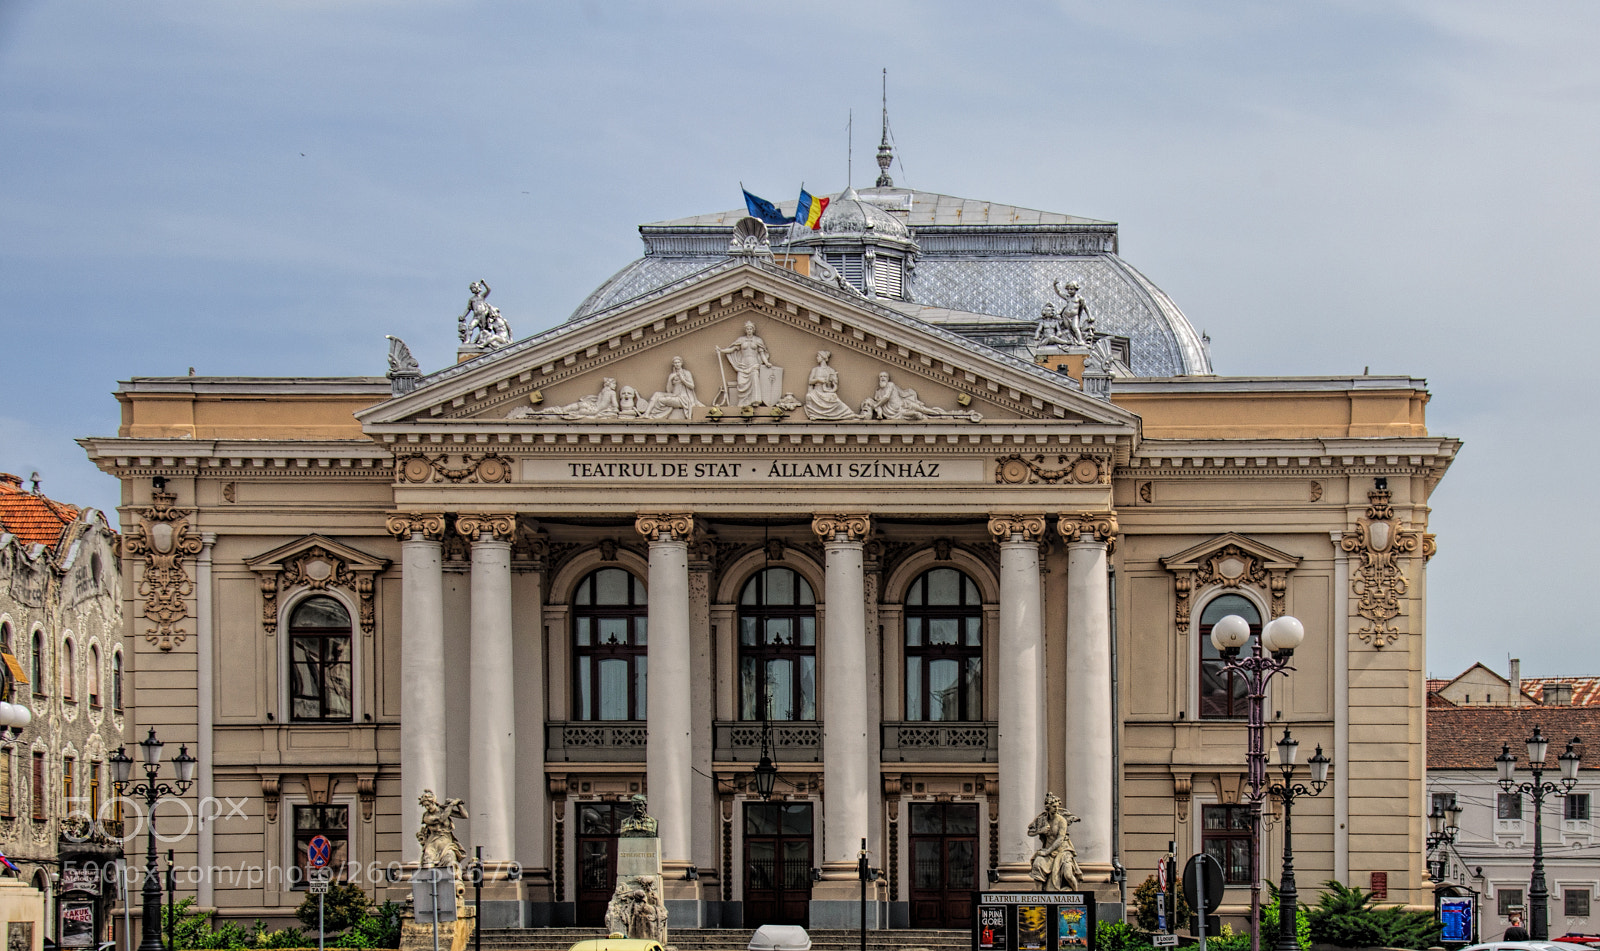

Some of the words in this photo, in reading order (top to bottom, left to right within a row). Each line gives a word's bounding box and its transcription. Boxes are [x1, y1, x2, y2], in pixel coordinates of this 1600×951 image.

[568, 463, 657, 477] TEATRUL
[661, 463, 688, 477] DE
[694, 463, 742, 477] STAT
[768, 460, 843, 477] ÁLLAMI
[848, 460, 940, 477] SZÍNHÁZ
[983, 895, 1019, 903] TEATRUL
[1021, 895, 1052, 903] REGINA
[1053, 895, 1081, 903] MARIA
[64, 908, 89, 918] KAKUK
